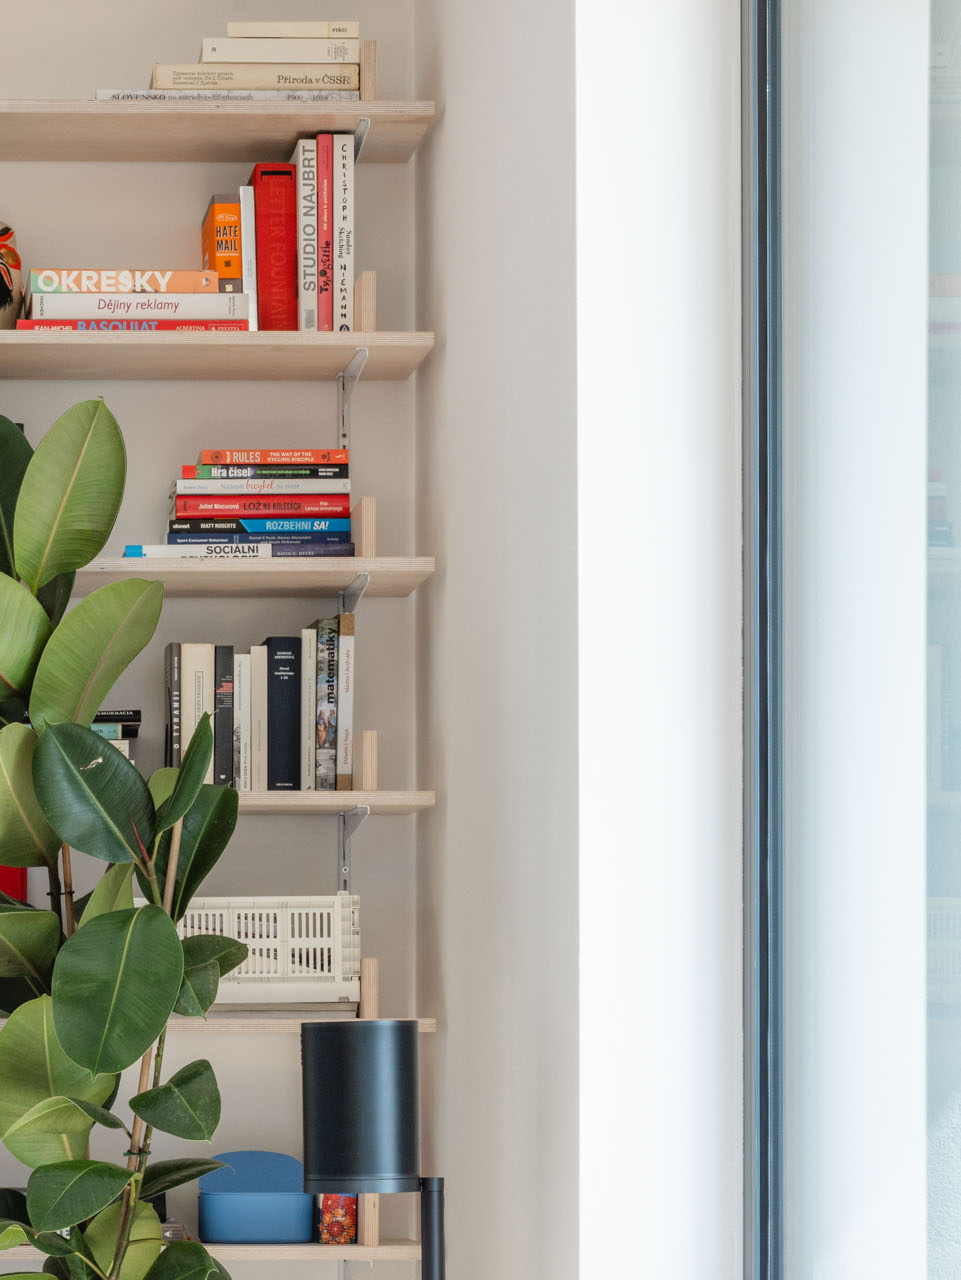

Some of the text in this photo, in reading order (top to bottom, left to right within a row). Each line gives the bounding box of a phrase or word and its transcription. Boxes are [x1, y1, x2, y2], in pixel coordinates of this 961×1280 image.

[277, 74, 313, 85] Příroda
[322, 72, 351, 84] ČSSR
[302, 145, 316, 292] STUDIO NAJBRT
[216, 226, 239, 238] HATE
[217, 240, 239, 252] MAIL
[97, 299, 180, 313] Dějiny reklamy
[232, 451, 261, 463] RULES
[211, 466, 251, 477] Hra čísel
[243, 500, 261, 511] LOŽ
[266, 521, 311, 530] ROZBEHNI
[313, 521, 329, 530] SA!
[325, 627, 337, 704] matematiky
